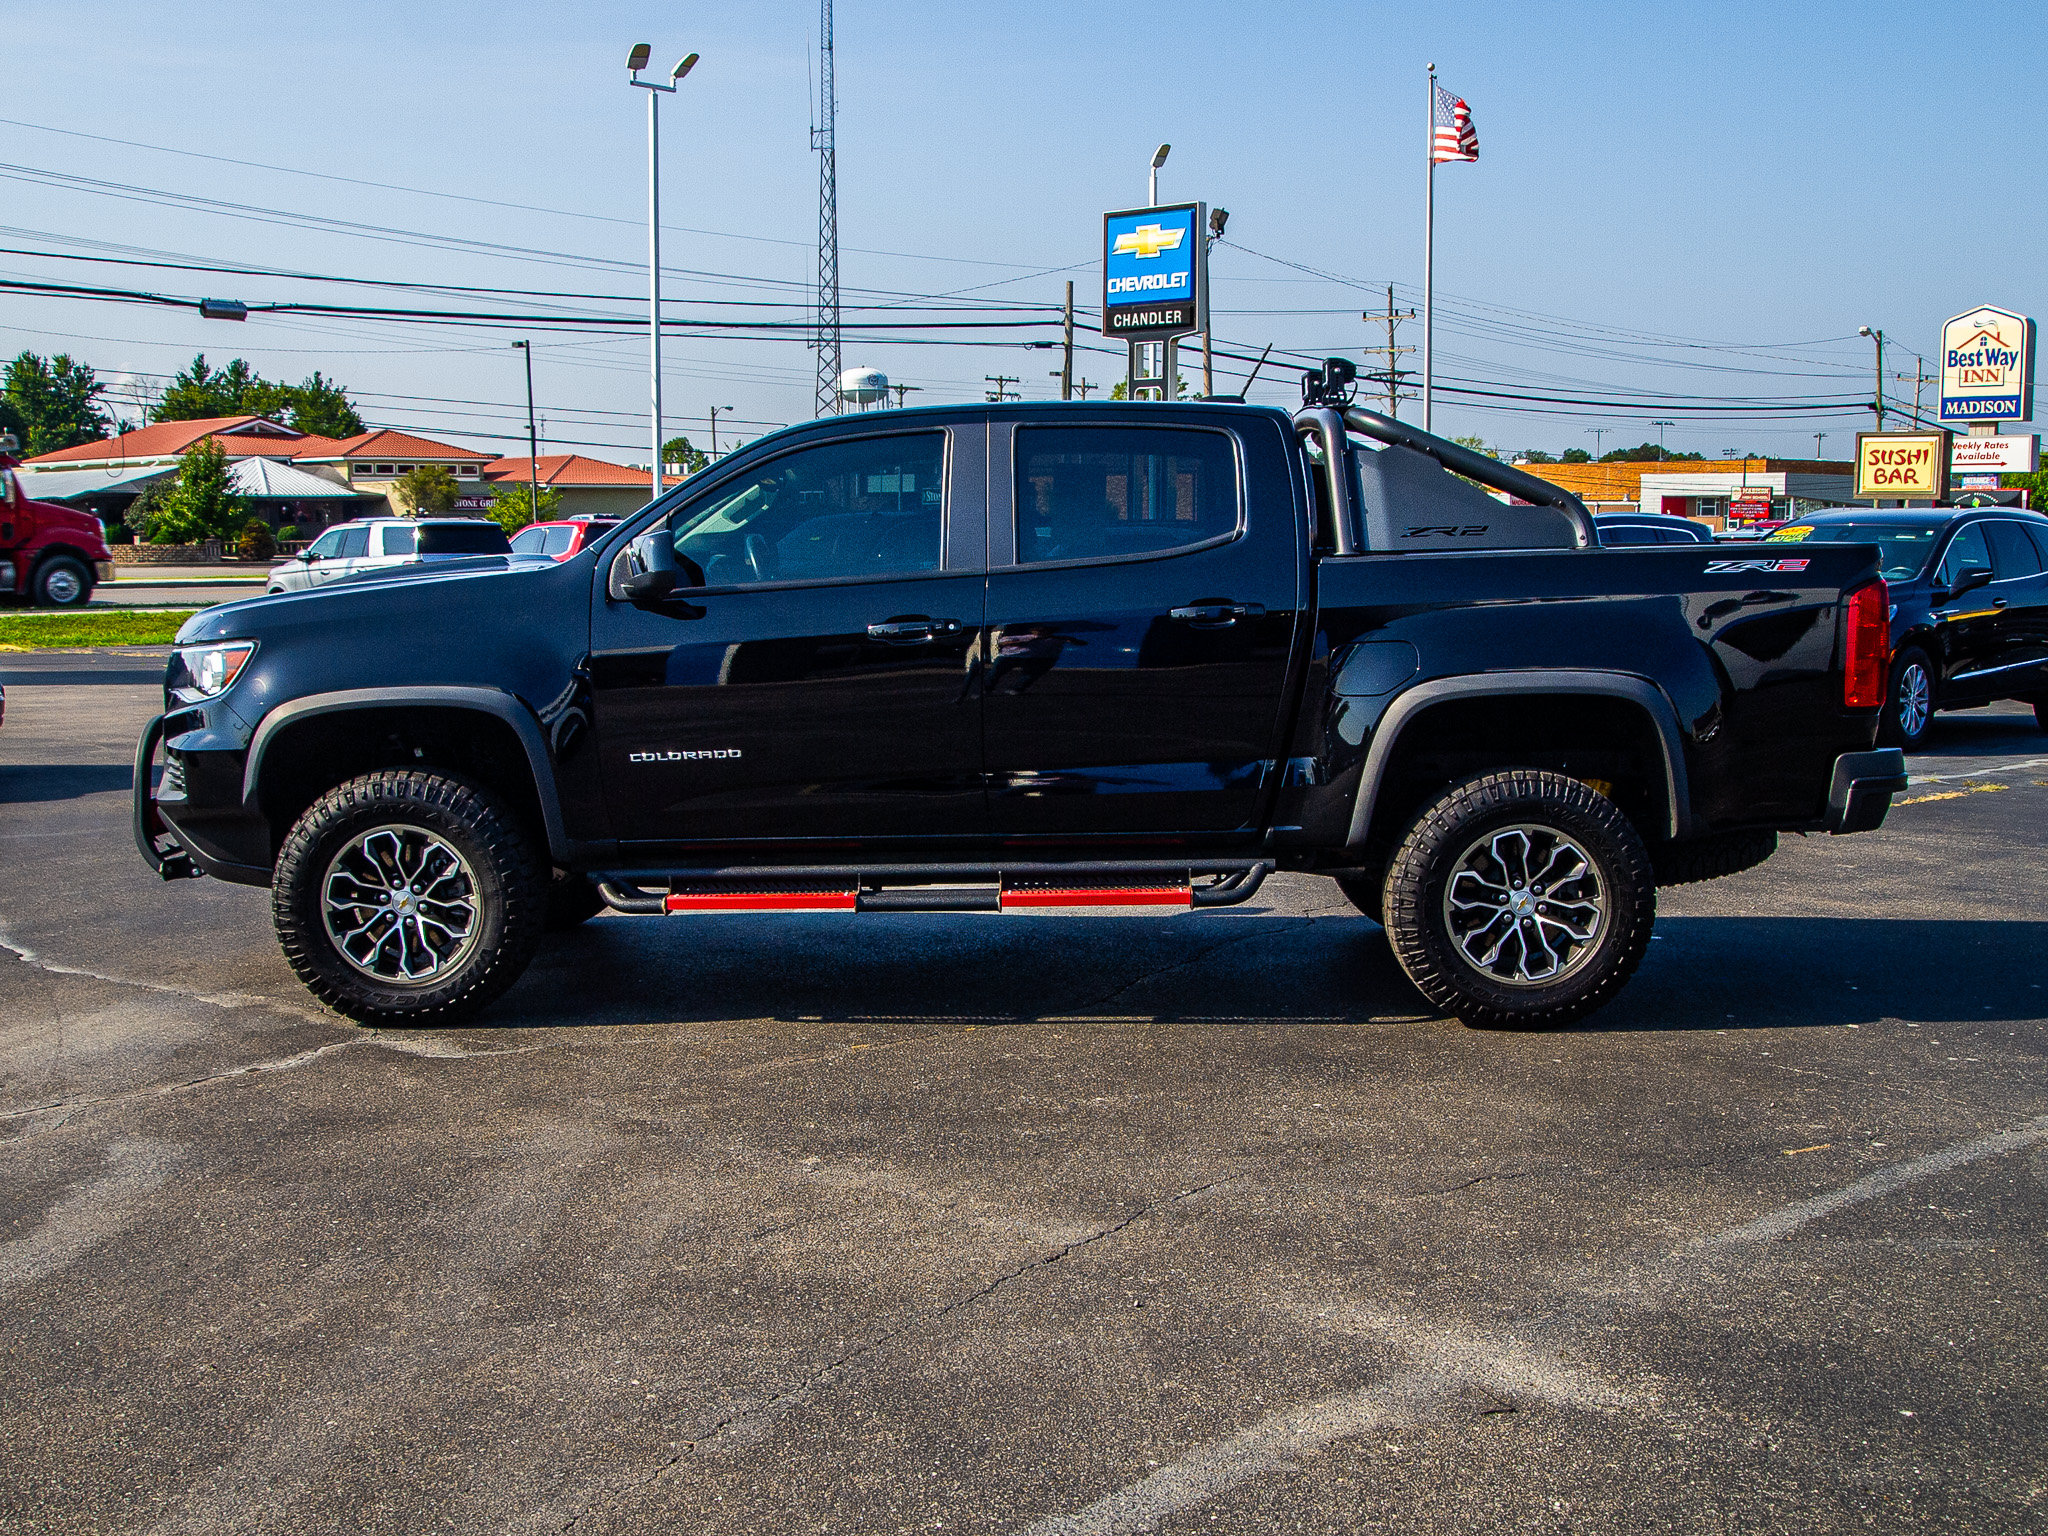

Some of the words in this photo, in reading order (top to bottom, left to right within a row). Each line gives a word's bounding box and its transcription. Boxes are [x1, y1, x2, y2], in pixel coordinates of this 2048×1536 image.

[1107, 272, 1188, 293] CHEVROLET
[1113, 310, 1182, 327] CHANDLER
[1948, 349, 1983, 367] Best
[1985, 348, 2019, 371] Way
[1963, 369, 2000, 383] INN
[1944, 400, 2017, 415] MADISON
[1984, 441, 2009, 449] Rates
[1868, 449, 1929, 466] SUSHI
[1956, 452, 2000, 460] Available
[1873, 468, 1919, 485] BAR
[1400, 525, 1490, 538] ZR2
[1703, 559, 1811, 573] ZR2
[629, 749, 742, 762] COLORADO
